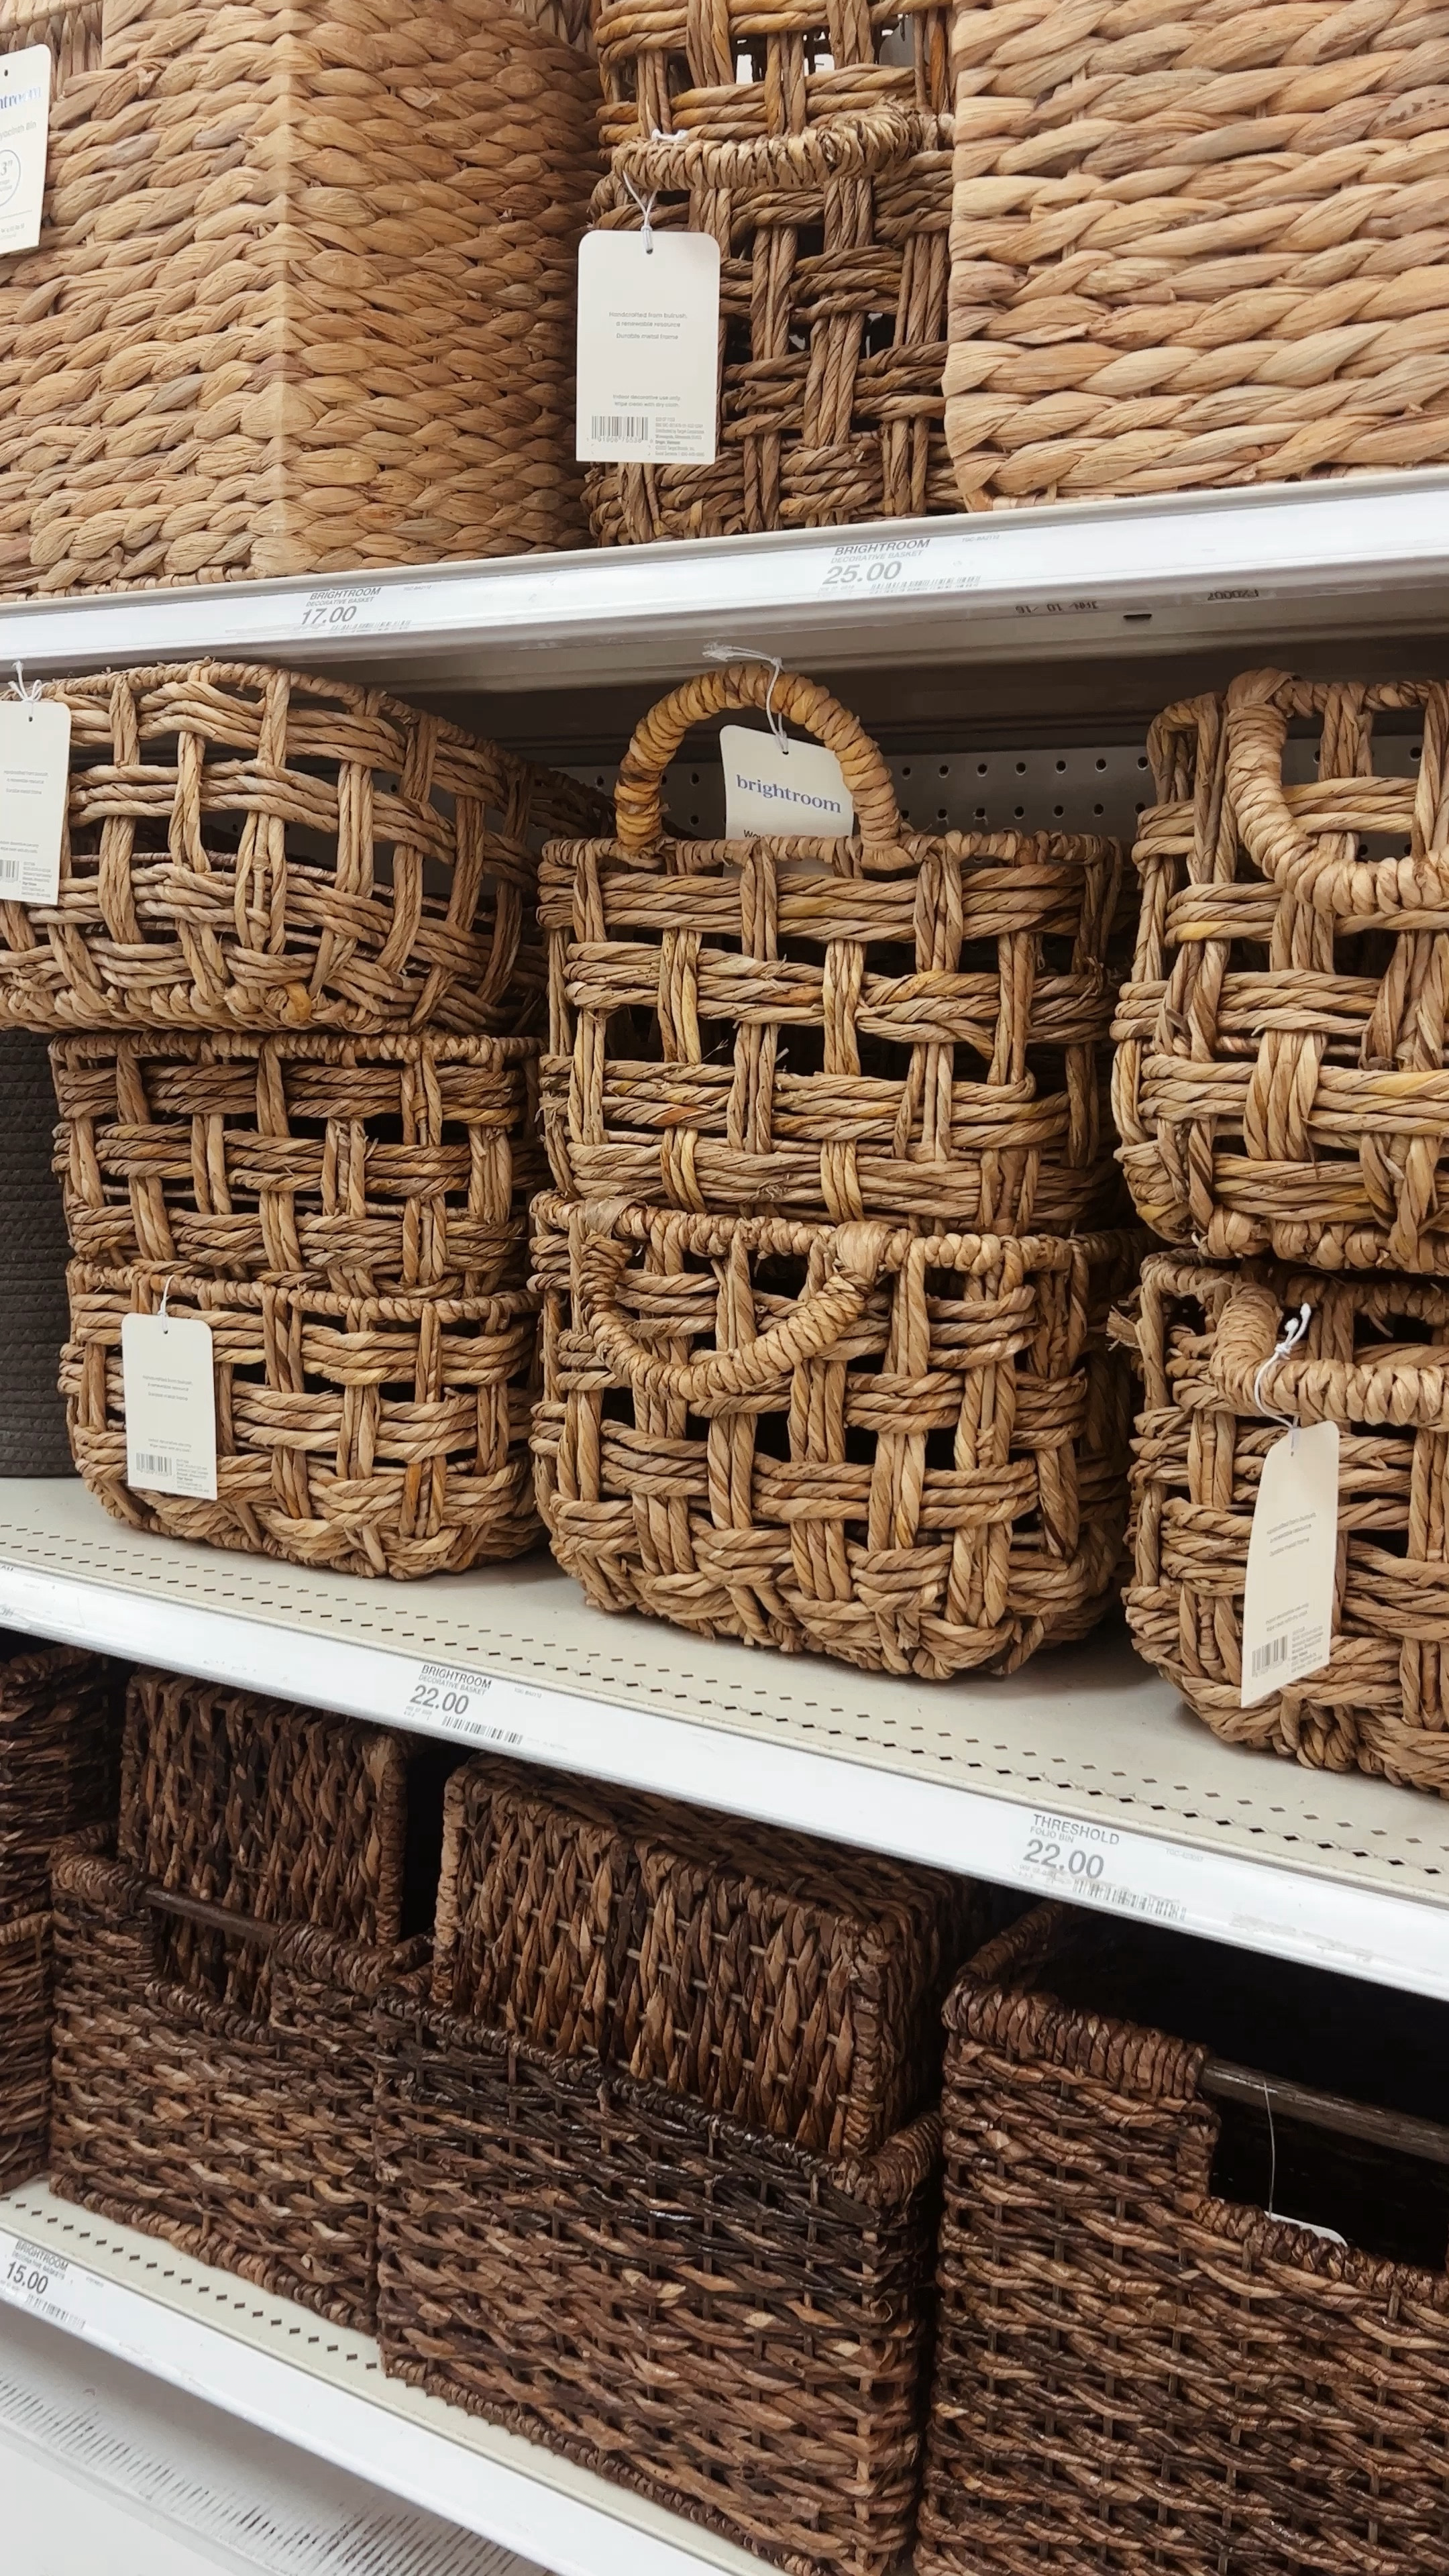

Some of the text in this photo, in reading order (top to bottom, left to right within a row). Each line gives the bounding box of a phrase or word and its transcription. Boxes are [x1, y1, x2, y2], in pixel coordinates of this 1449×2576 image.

[830, 549, 924, 564] DECORATIVE BASKET
[834, 539, 930, 556] BRIGHTROOM
[822, 561, 903, 586] 25.00
[306, 596, 375, 607] DECORATIVE BASKET
[309, 587, 382, 601] BRIGHTROOM
[301, 605, 358, 625] 17.00
[736, 774, 841, 814] brightroom
[419, 1674, 486, 1697] DECORATIVE BASKET
[421, 1664, 492, 1689] BRIGHTROOM
[410, 1685, 470, 1715] 22.00
[1033, 1814, 1120, 1845] THRESHOLD
[1059, 1833, 1074, 1843] BIN
[1023, 1839, 1104, 1879] 22.00
[15, 2240, 69, 2271] BRIGHTROOM
[7, 2261, 48, 2294] 15.00
